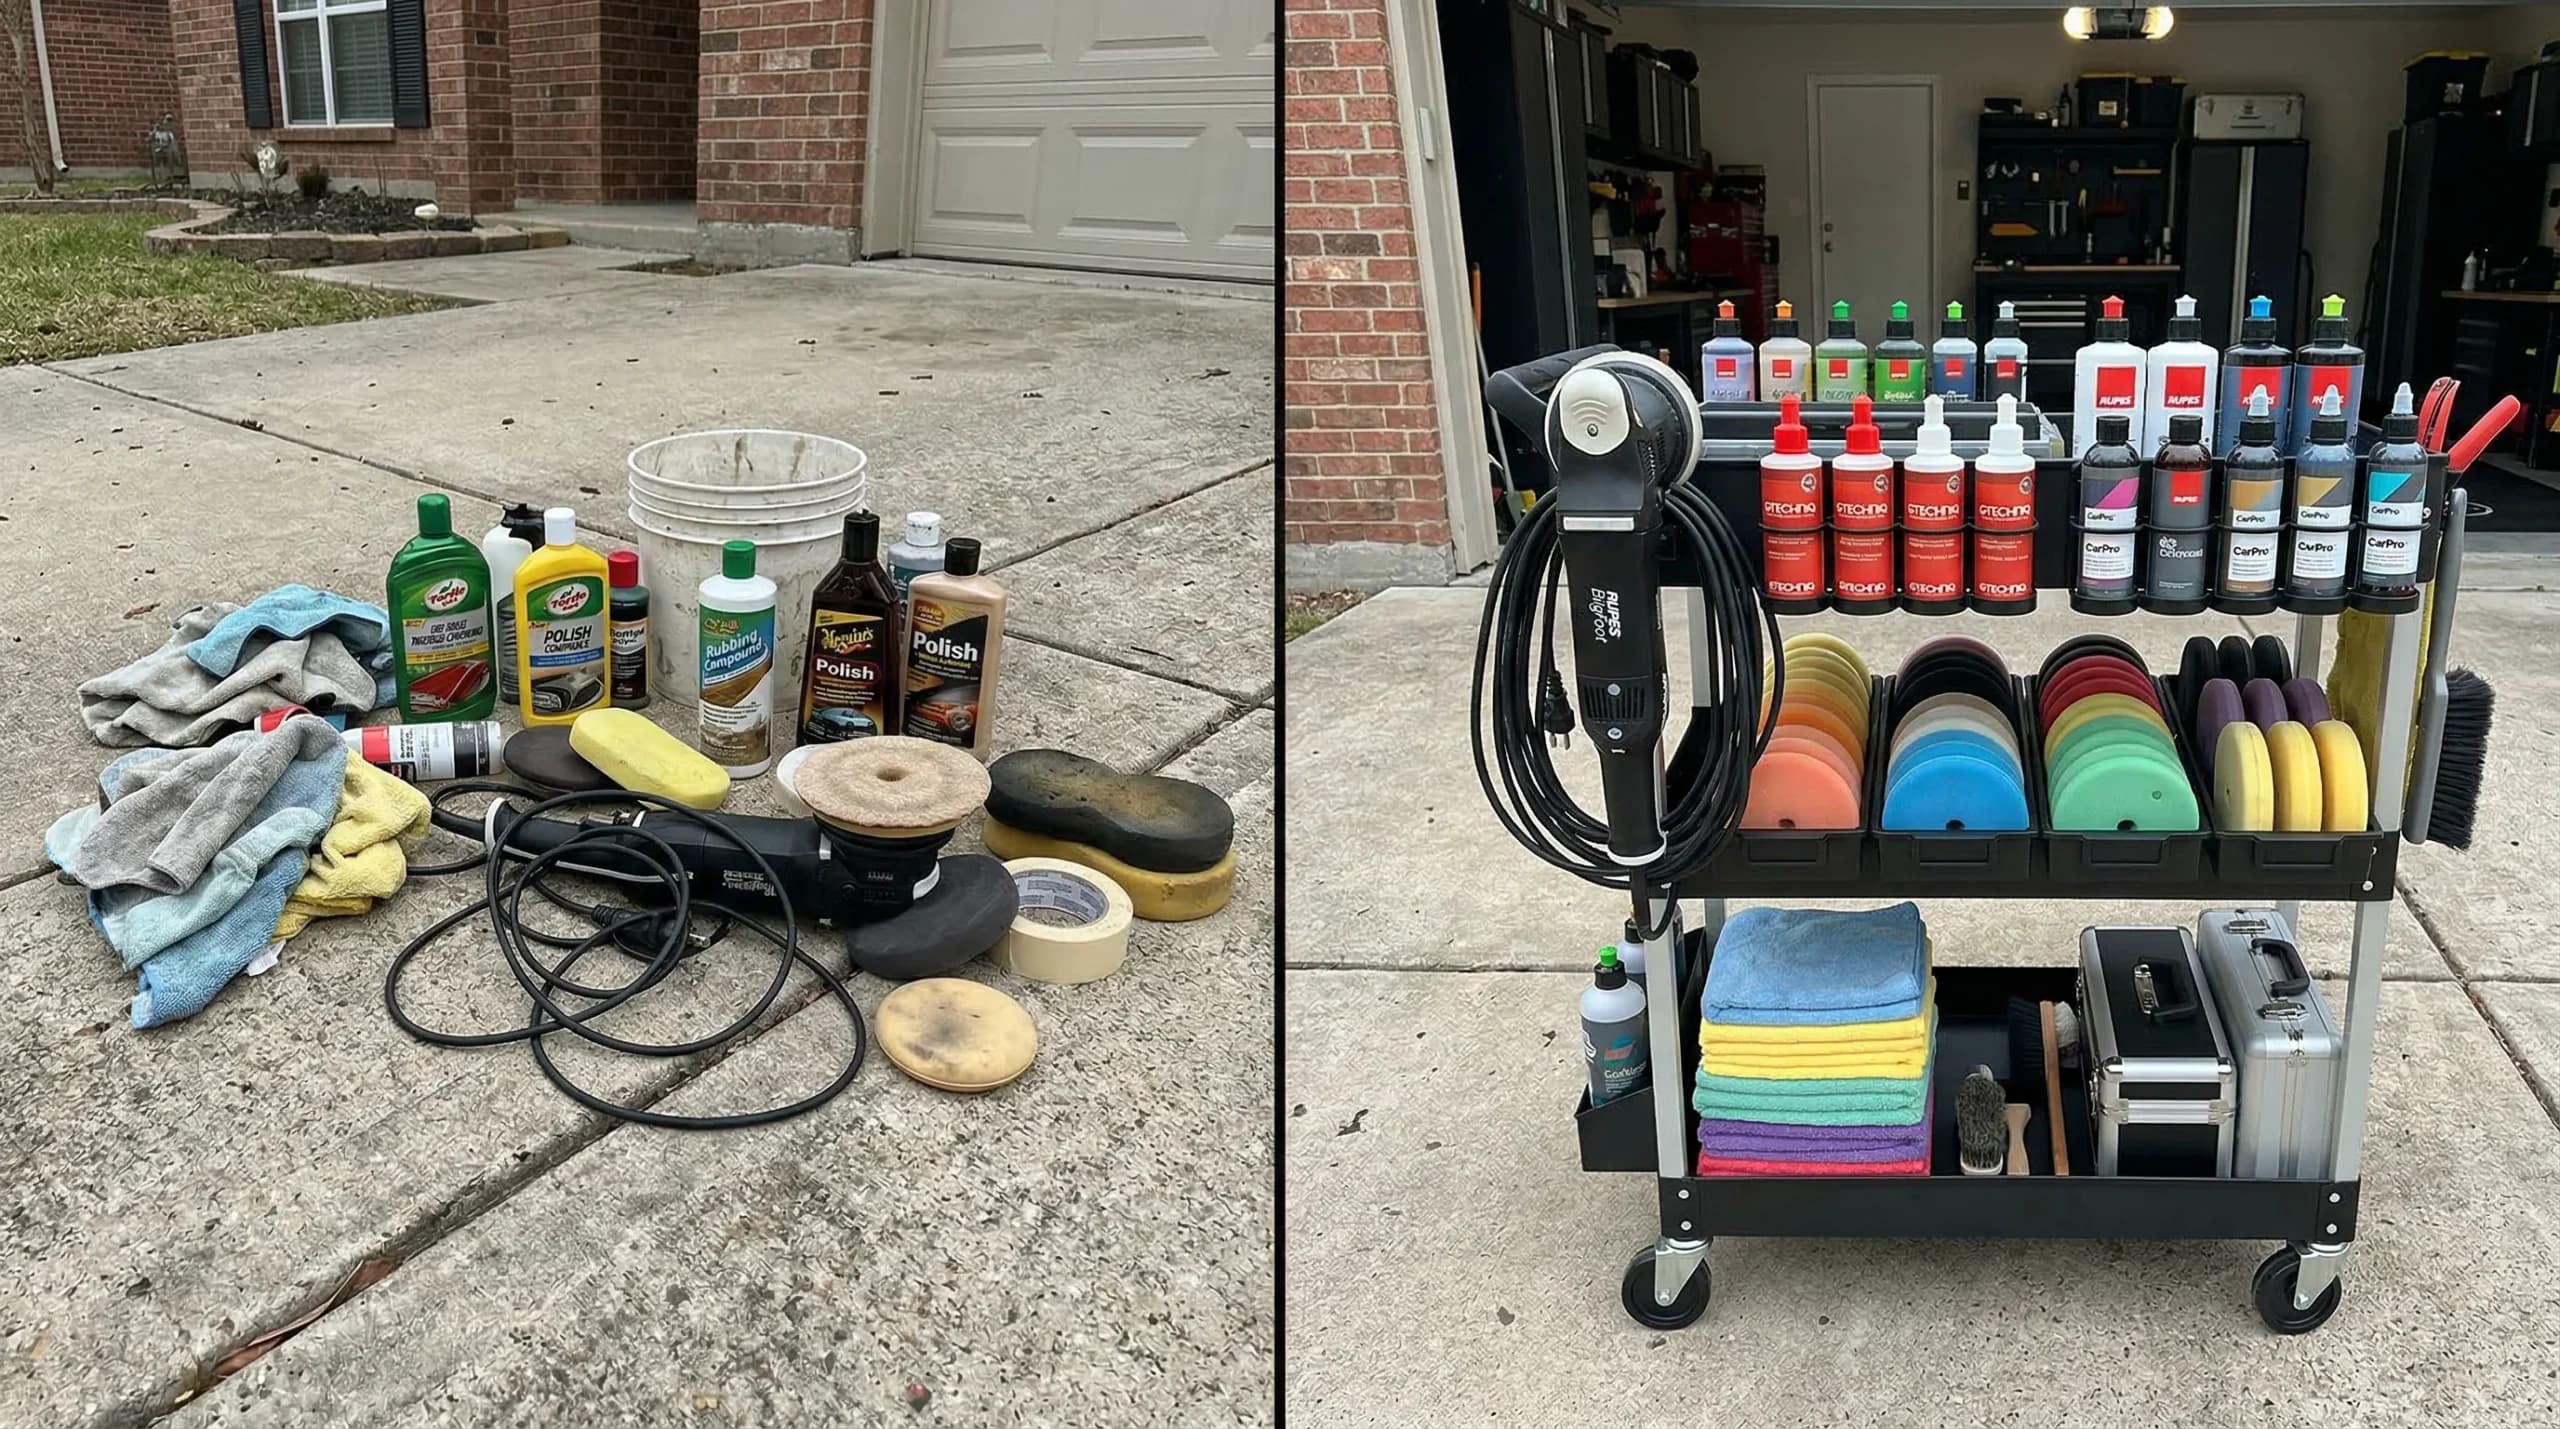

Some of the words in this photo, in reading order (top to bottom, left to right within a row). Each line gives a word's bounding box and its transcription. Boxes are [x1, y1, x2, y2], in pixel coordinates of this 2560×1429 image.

[2085, 543, 2121, 554] CarPro
[2233, 546, 2269, 557] CarPro
[2368, 537, 2405, 548] CarPro
[1606, 590, 1621, 639] RUPES
[544, 625, 592, 644] POLISH
[913, 631, 978, 661] Polish
[816, 658, 874, 680] Polish
